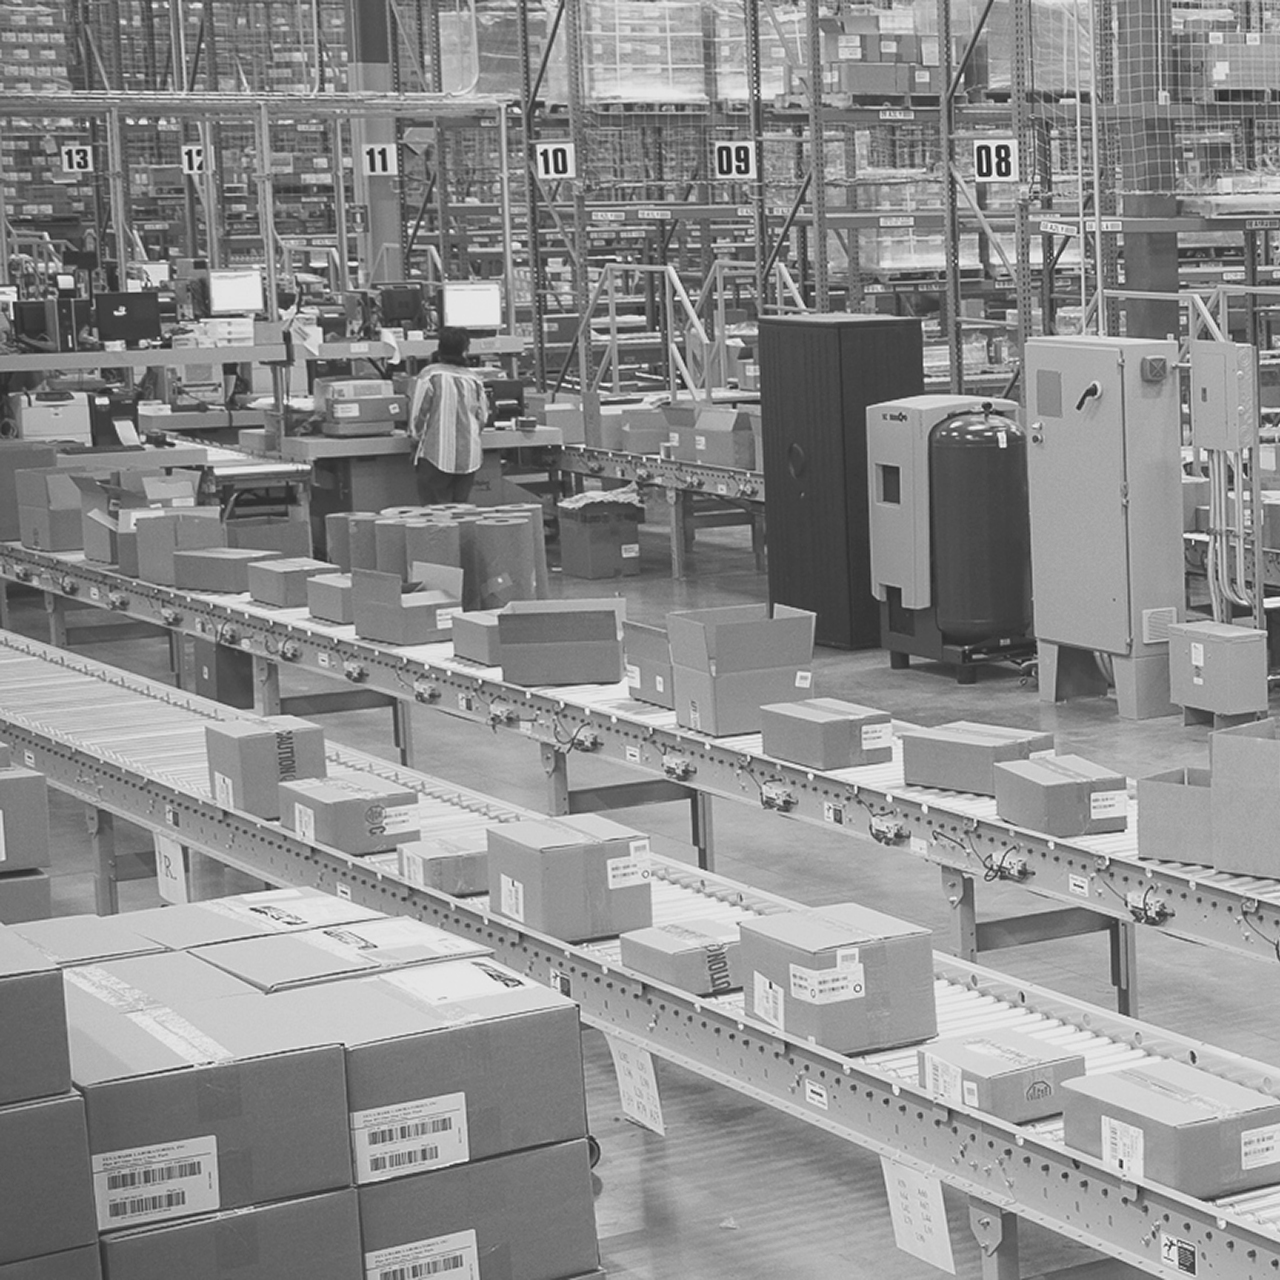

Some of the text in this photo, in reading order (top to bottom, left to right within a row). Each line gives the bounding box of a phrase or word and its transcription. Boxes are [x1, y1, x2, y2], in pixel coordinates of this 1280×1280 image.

[64, 149, 88, 170] 13
[366, 148, 387, 172] 11
[540, 149, 567, 174] 10
[718, 147, 750, 175] 09
[977, 145, 1010, 177] 08
